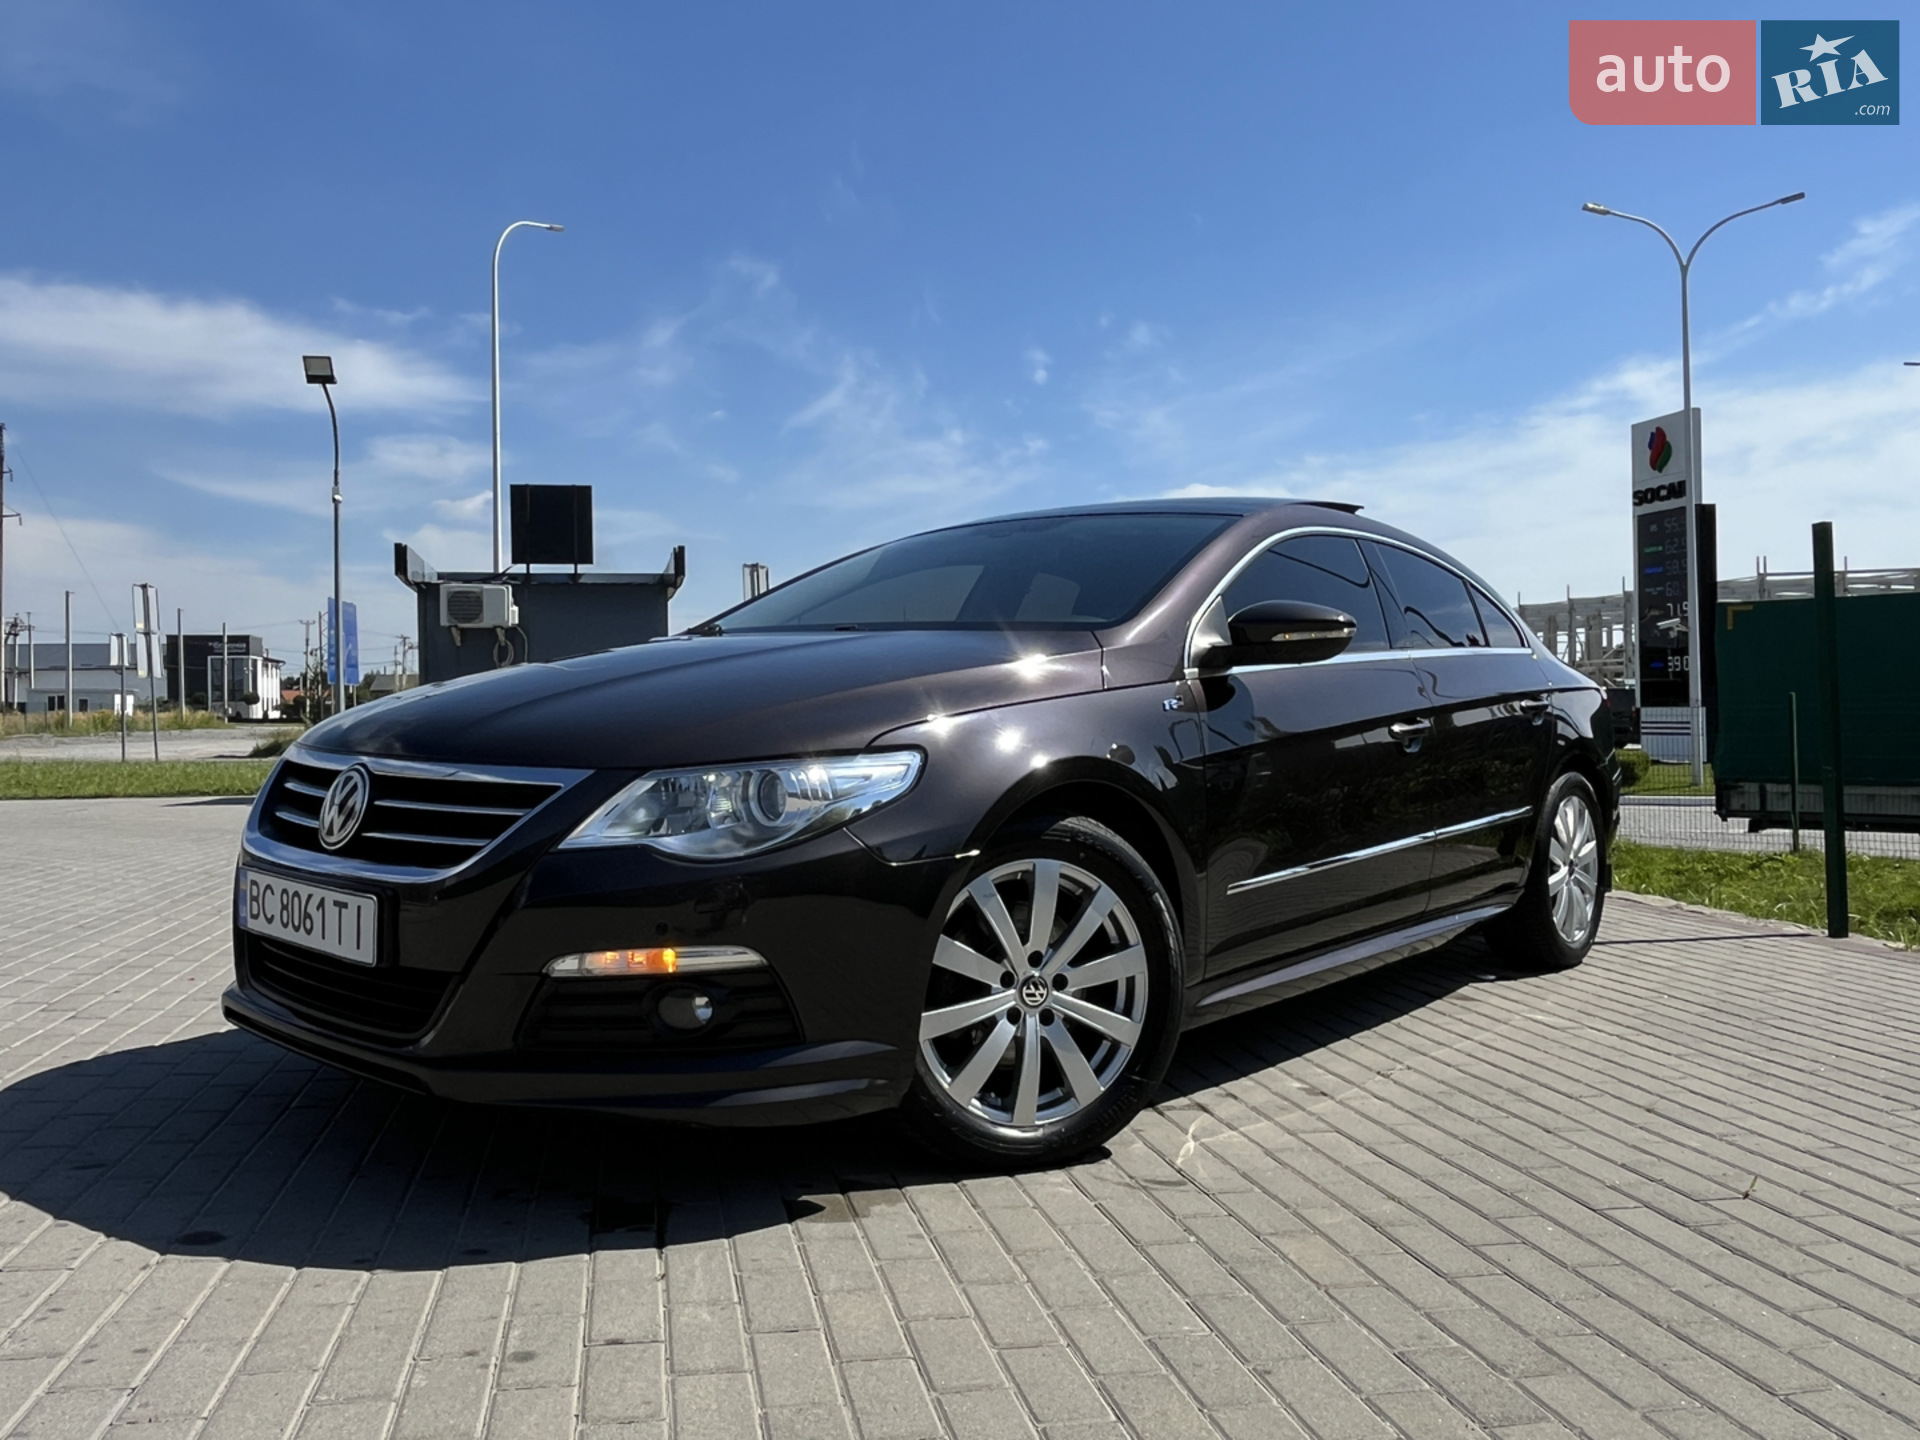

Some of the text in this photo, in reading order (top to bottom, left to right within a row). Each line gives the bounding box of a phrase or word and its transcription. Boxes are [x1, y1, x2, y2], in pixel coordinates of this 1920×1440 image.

[250, 879, 361, 950] BC 8061 TI
